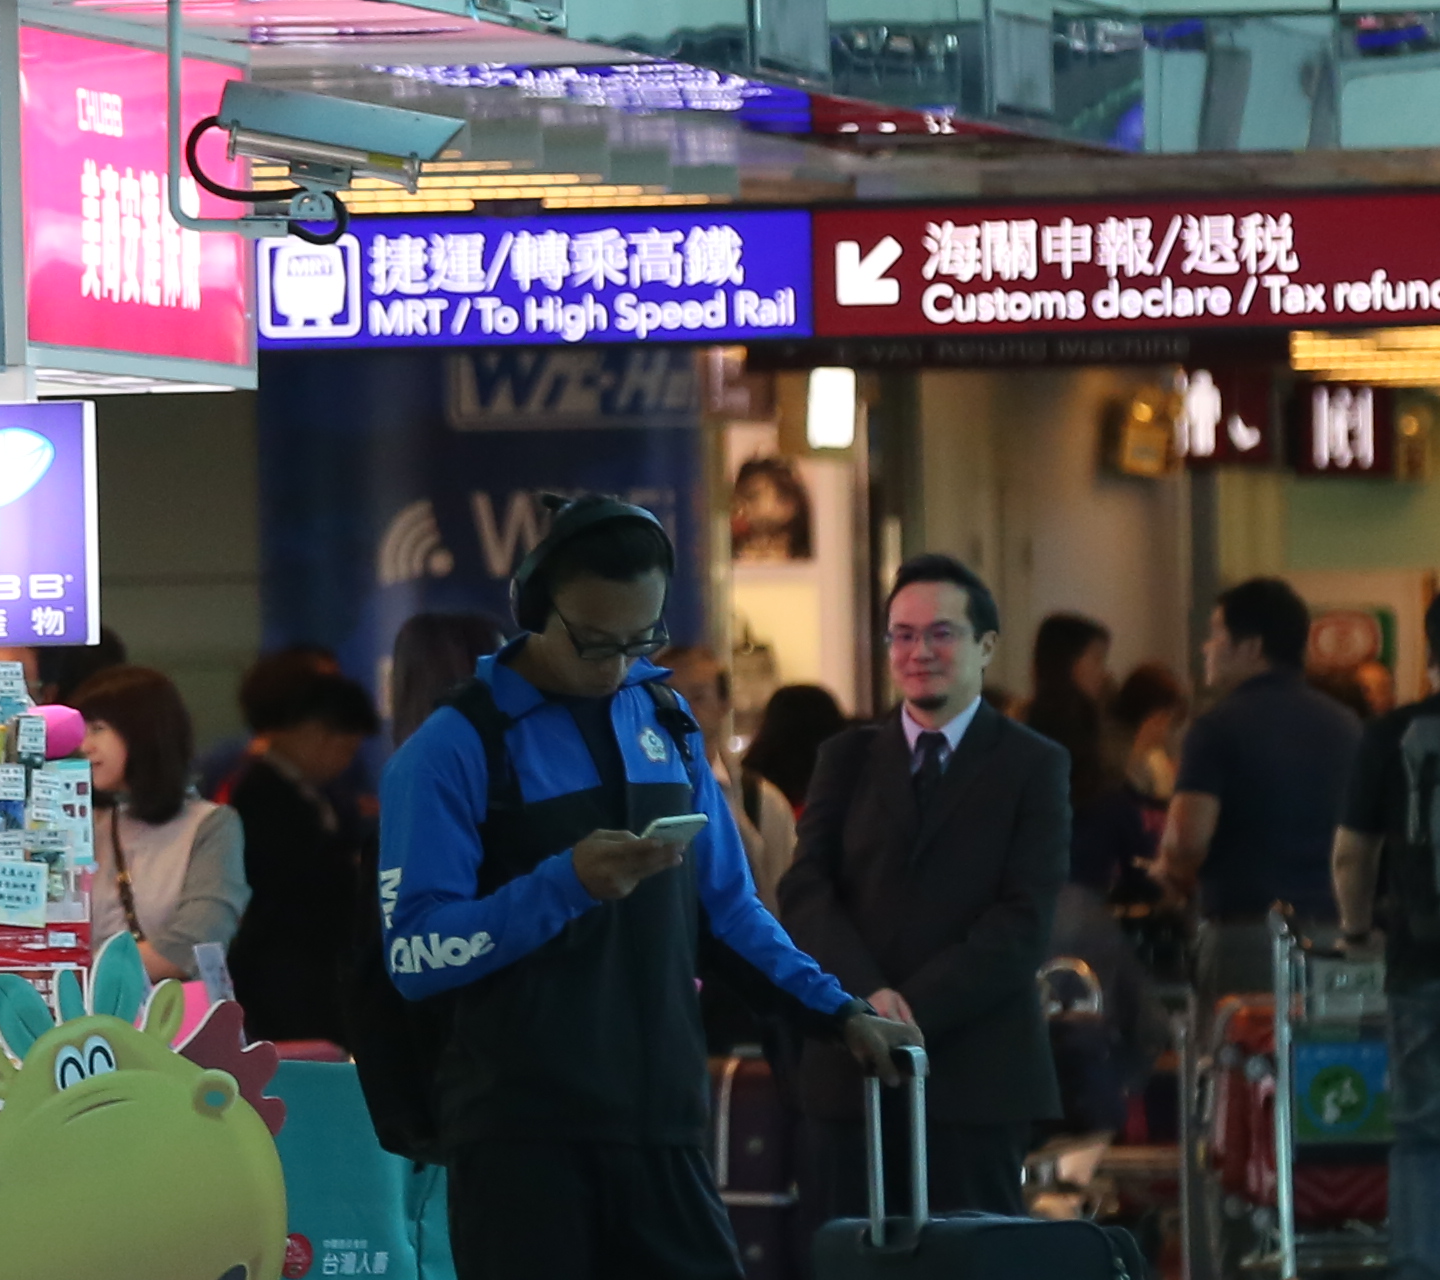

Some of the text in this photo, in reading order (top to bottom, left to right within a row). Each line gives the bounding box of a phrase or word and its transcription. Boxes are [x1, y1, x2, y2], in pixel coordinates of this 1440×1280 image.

[368, 224, 744, 295] 捷運/轉乘高鐵
[369, 298, 449, 336] MRT
[474, 296, 519, 335] To
[525, 292, 608, 342] High
[614, 289, 727, 340] Speed
[733, 286, 795, 328] Rail
[922, 283, 1086, 324] Customs
[1092, 275, 1232, 318] declare
[1261, 274, 1326, 314] Tax
